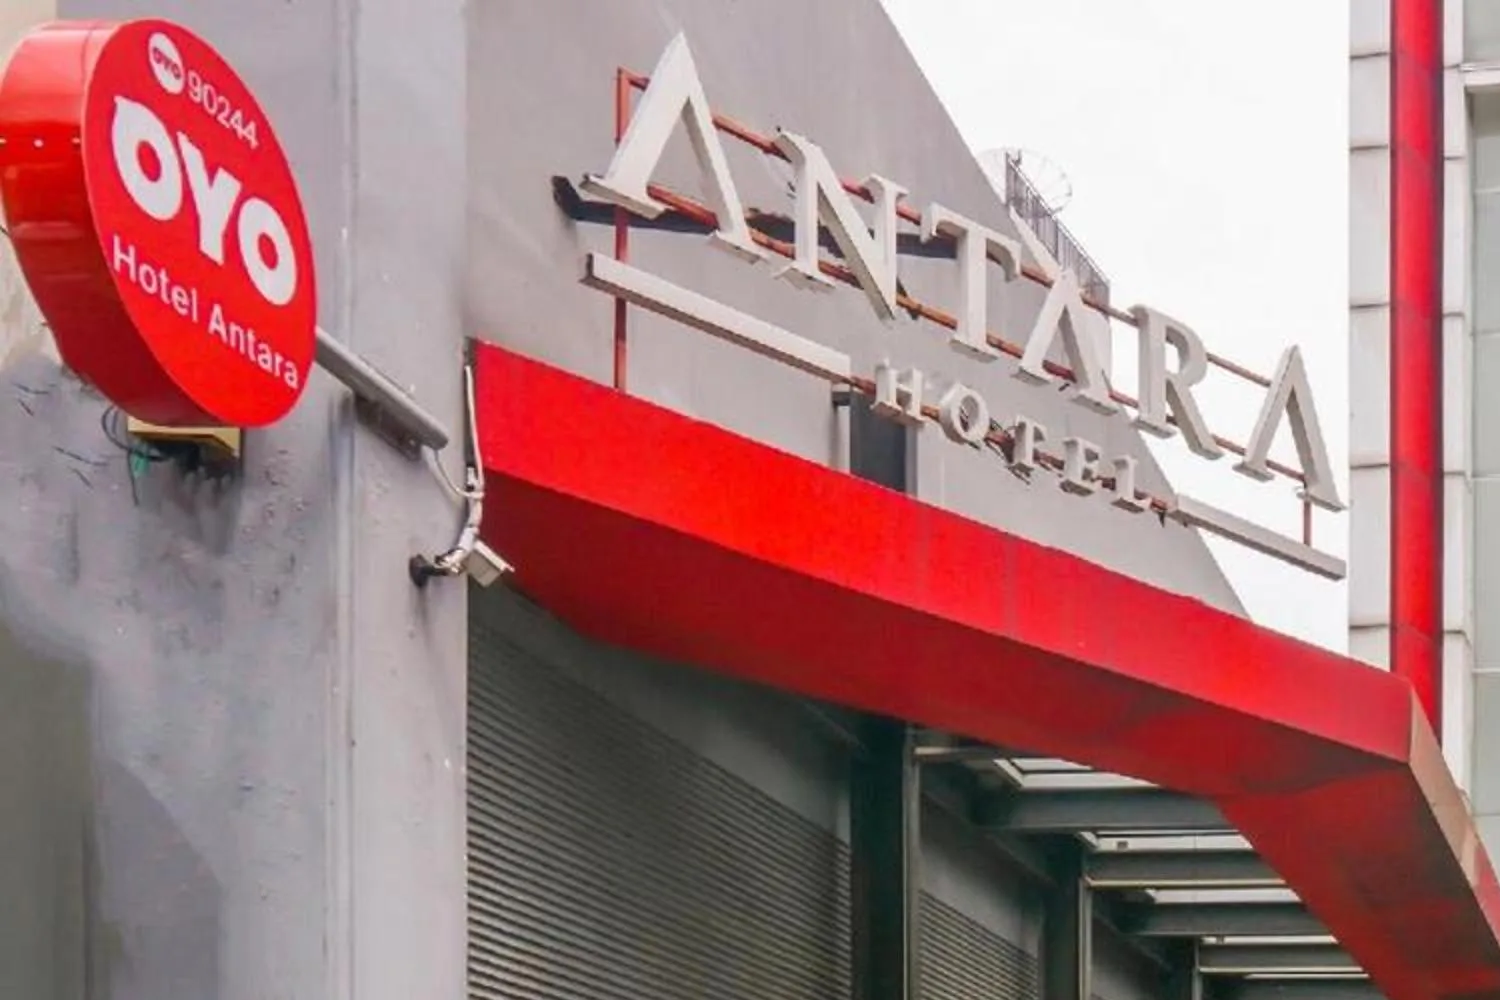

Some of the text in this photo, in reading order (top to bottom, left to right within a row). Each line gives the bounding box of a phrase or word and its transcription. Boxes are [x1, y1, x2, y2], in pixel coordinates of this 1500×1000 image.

[187, 69, 259, 149] 90244
[111, 95, 298, 306] OYO
[581, 31, 1348, 512] ANTARA
[112, 233, 300, 390] Hotel Antara
[871, 358, 1151, 513] HOTEL
